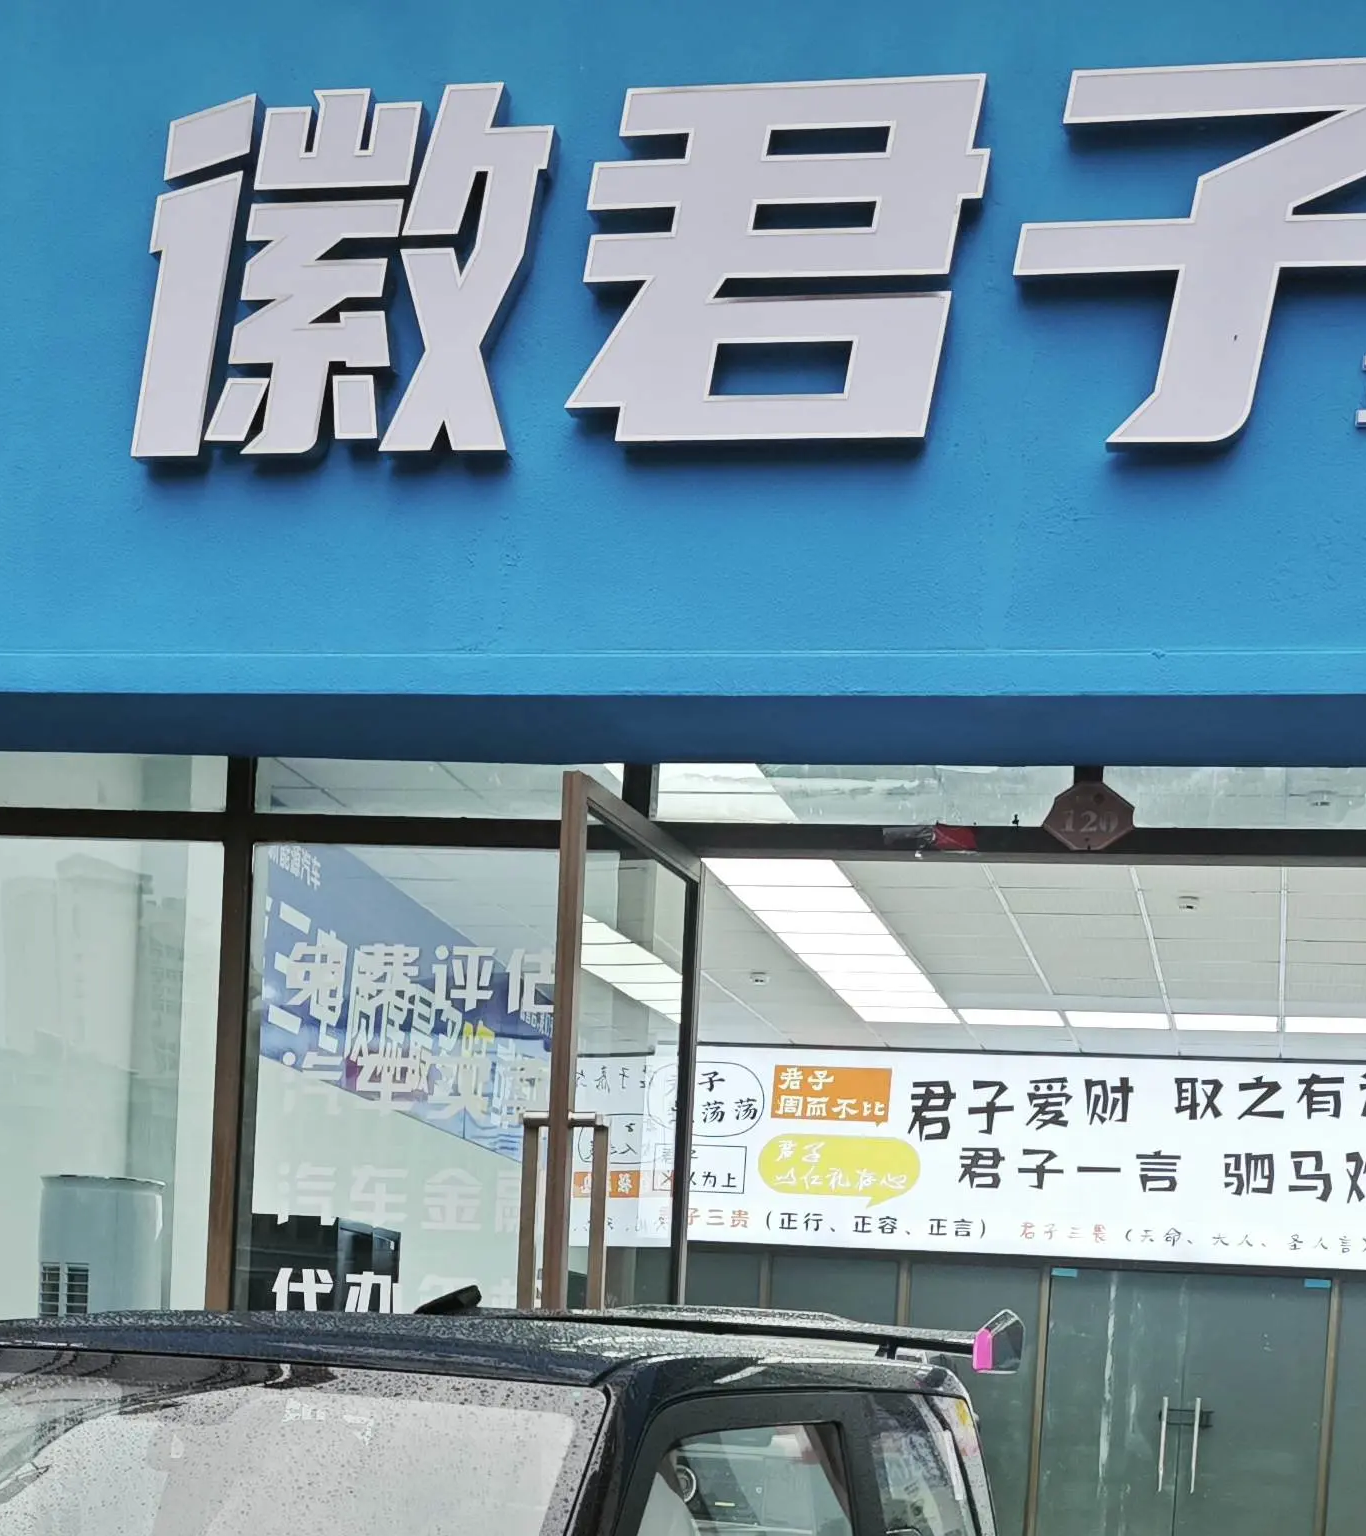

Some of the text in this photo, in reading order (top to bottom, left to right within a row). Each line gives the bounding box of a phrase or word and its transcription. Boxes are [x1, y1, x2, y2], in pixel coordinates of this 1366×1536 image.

[780, 1067, 834, 1090] 君子
[775, 1095, 885, 1118] 周而不比
[907, 1074, 1134, 1141] 君子爱财
[958, 1147, 1181, 1193] 君子一言
[1020, 1222, 1108, 1243] 君子三畏
